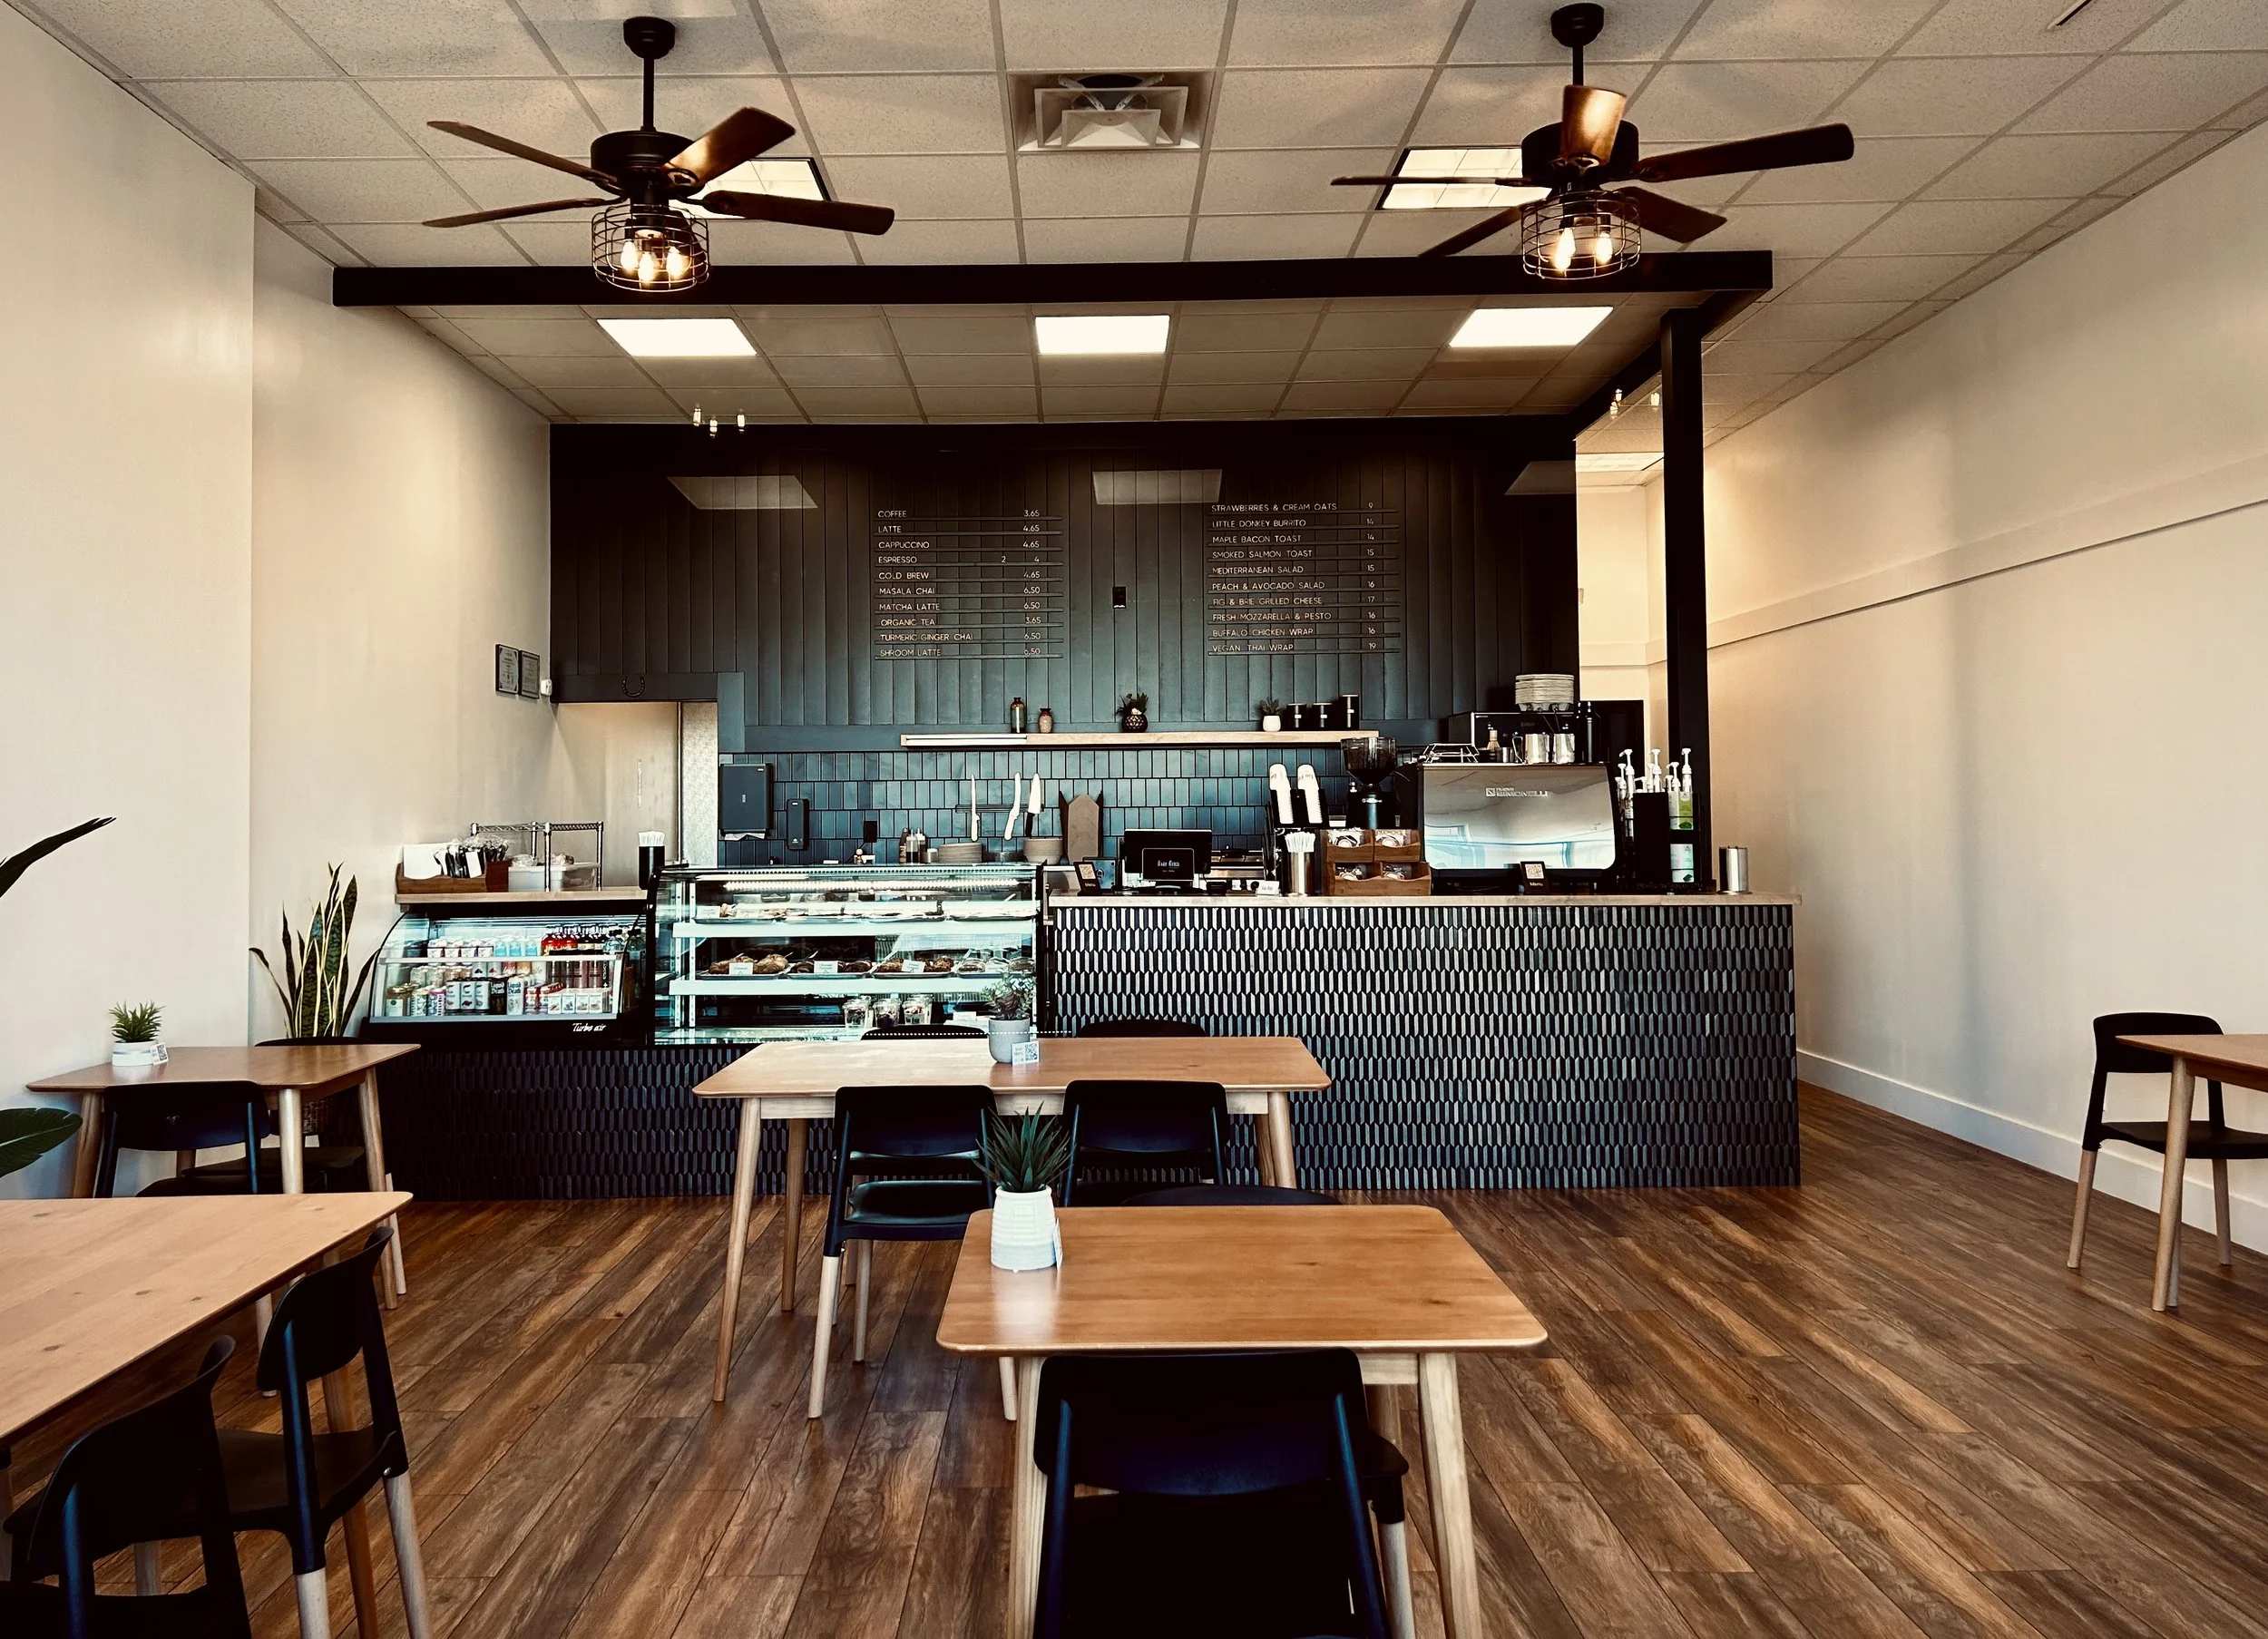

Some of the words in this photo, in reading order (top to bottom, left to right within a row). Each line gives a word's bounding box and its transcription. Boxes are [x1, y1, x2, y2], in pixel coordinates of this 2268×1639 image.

[1211, 504, 1269, 512] STRAWBERRIES
[1282, 503, 1311, 512] CREAM
[1314, 502, 1337, 511] OATS
[1023, 524, 1040, 532] 4.65
[1212, 520, 1236, 528] LITTLE
[1239, 520, 1270, 528] DONKEY
[1241, 535, 1271, 543] BACON
[1248, 551, 1282, 559] SALMON
[1286, 550, 1313, 558] TOAST
[878, 556, 917, 564] ESPRESSO
[1212, 566, 1274, 574] MEDITERRANEAN
[1298, 581, 1325, 590] SALAD
[1213, 598, 1226, 606] FIG
[1239, 598, 1255, 606] BRIE
[1293, 597, 1323, 605] CHEESE
[879, 603, 913, 611] MATCHA
[1023, 601, 1041, 610] 6.50
[880, 619, 917, 627] ORGANIC
[921, 633, 950, 641] GINGER
[1024, 632, 1041, 640] 6.50
[1252, 629, 1286, 637] CHICKEN
